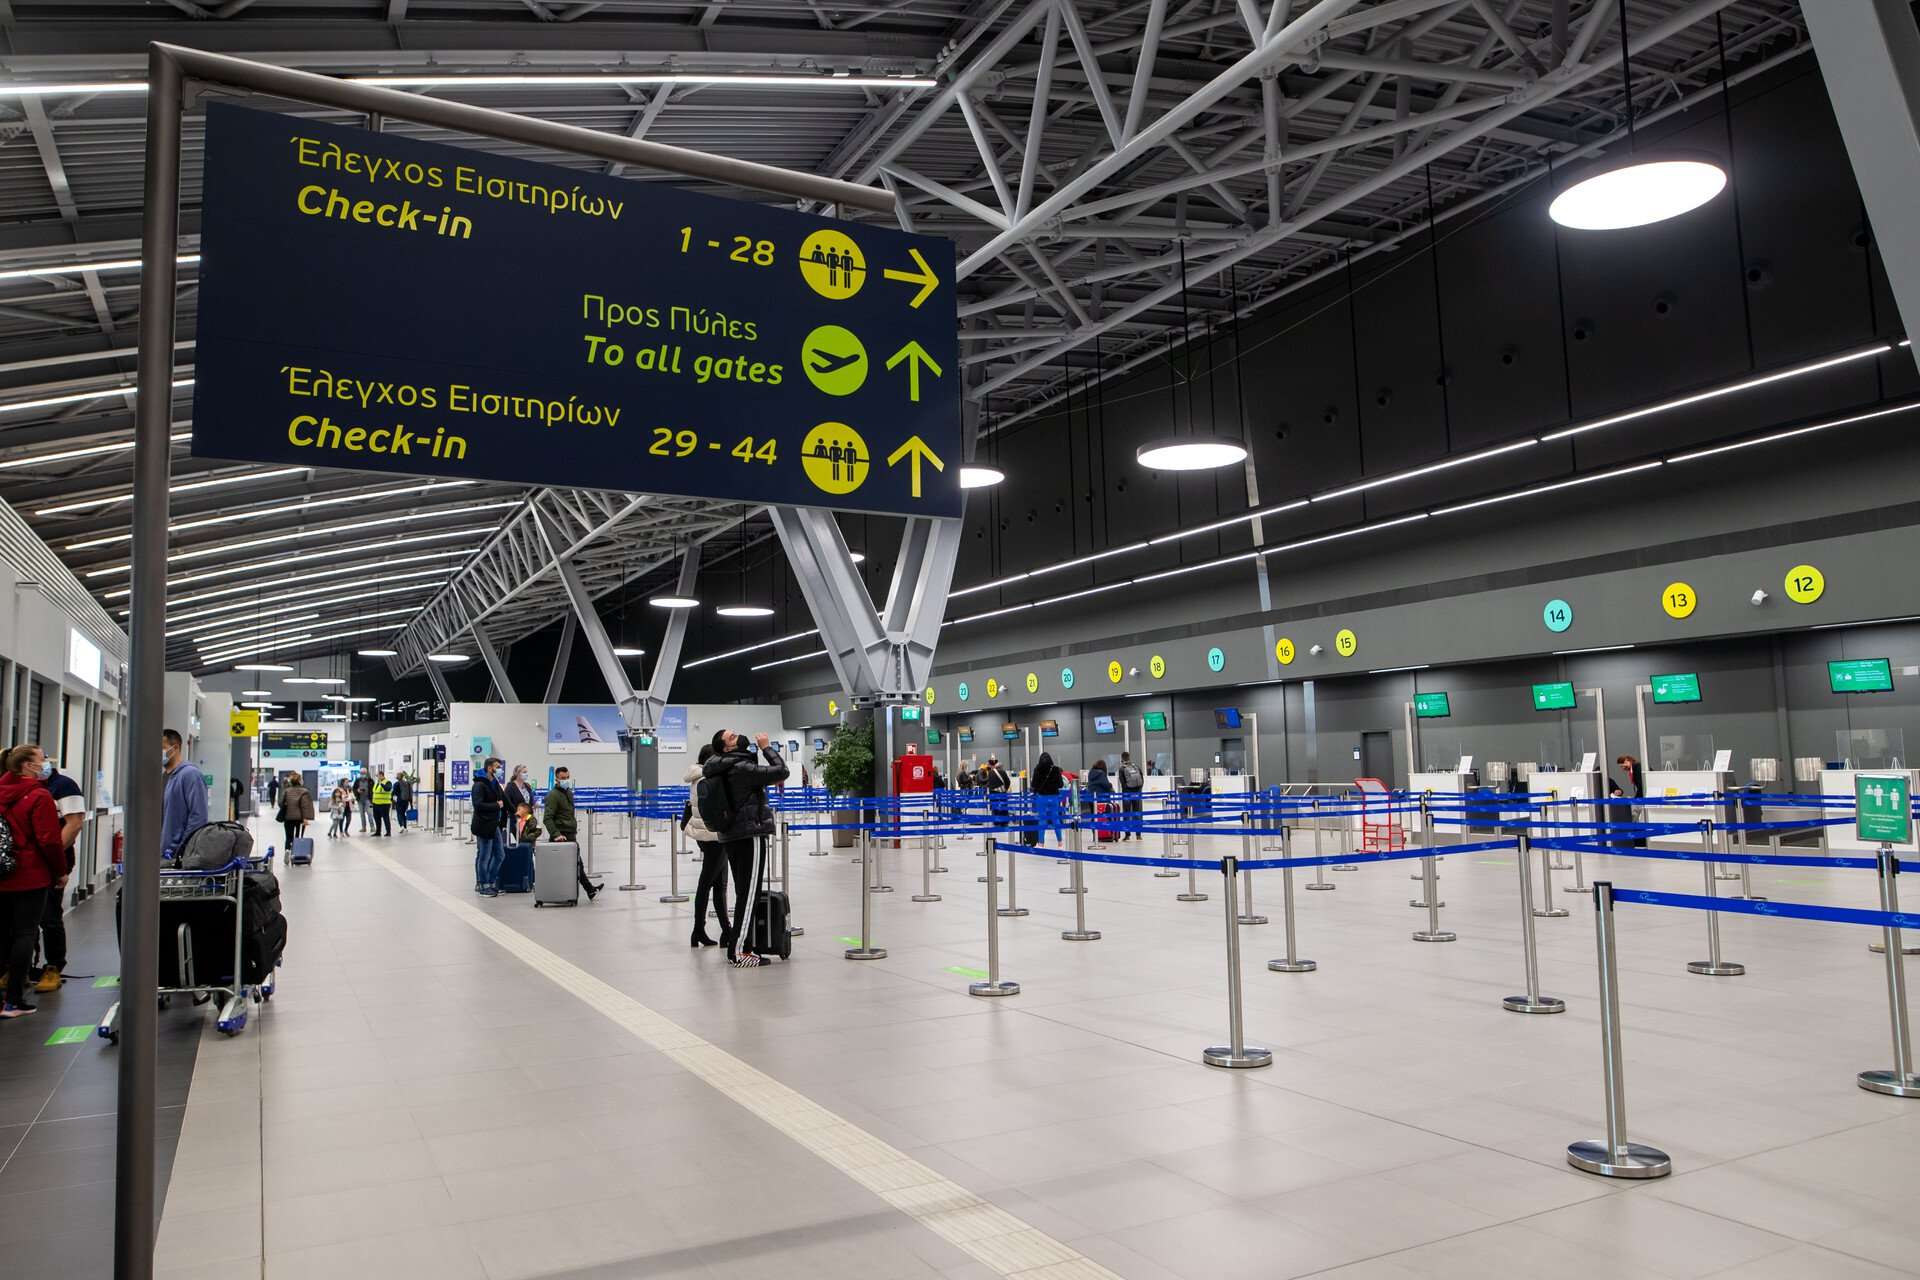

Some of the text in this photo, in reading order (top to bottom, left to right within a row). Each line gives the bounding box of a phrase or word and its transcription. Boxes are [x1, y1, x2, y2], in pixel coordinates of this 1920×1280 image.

[290, 136, 623, 220] Έλεγχος Εισιτηρίων
[297, 184, 473, 239] Check-in
[681, 226, 692, 254] 1
[729, 235, 775, 266] 28
[583, 294, 758, 341] Προς Πύλες
[584, 335, 784, 385] To all gates
[281, 366, 620, 427] Έλεγχος Εισιτηρίων
[288, 415, 467, 460] Check-in
[648, 427, 698, 457] 29
[731, 436, 777, 465] 44
[1794, 576, 1815, 592] 12
[1670, 593, 1688, 608] 13
[1549, 608, 1567, 623] 14
[1340, 637, 1352, 649] 15
[1280, 646, 1290, 657] 16
[1153, 662, 1162, 672] 18
[1211, 654, 1220, 665] 17
[1063, 672, 1072, 683] 20
[1111, 667, 1119, 677] 19
[1028, 679, 1036, 688] 21
